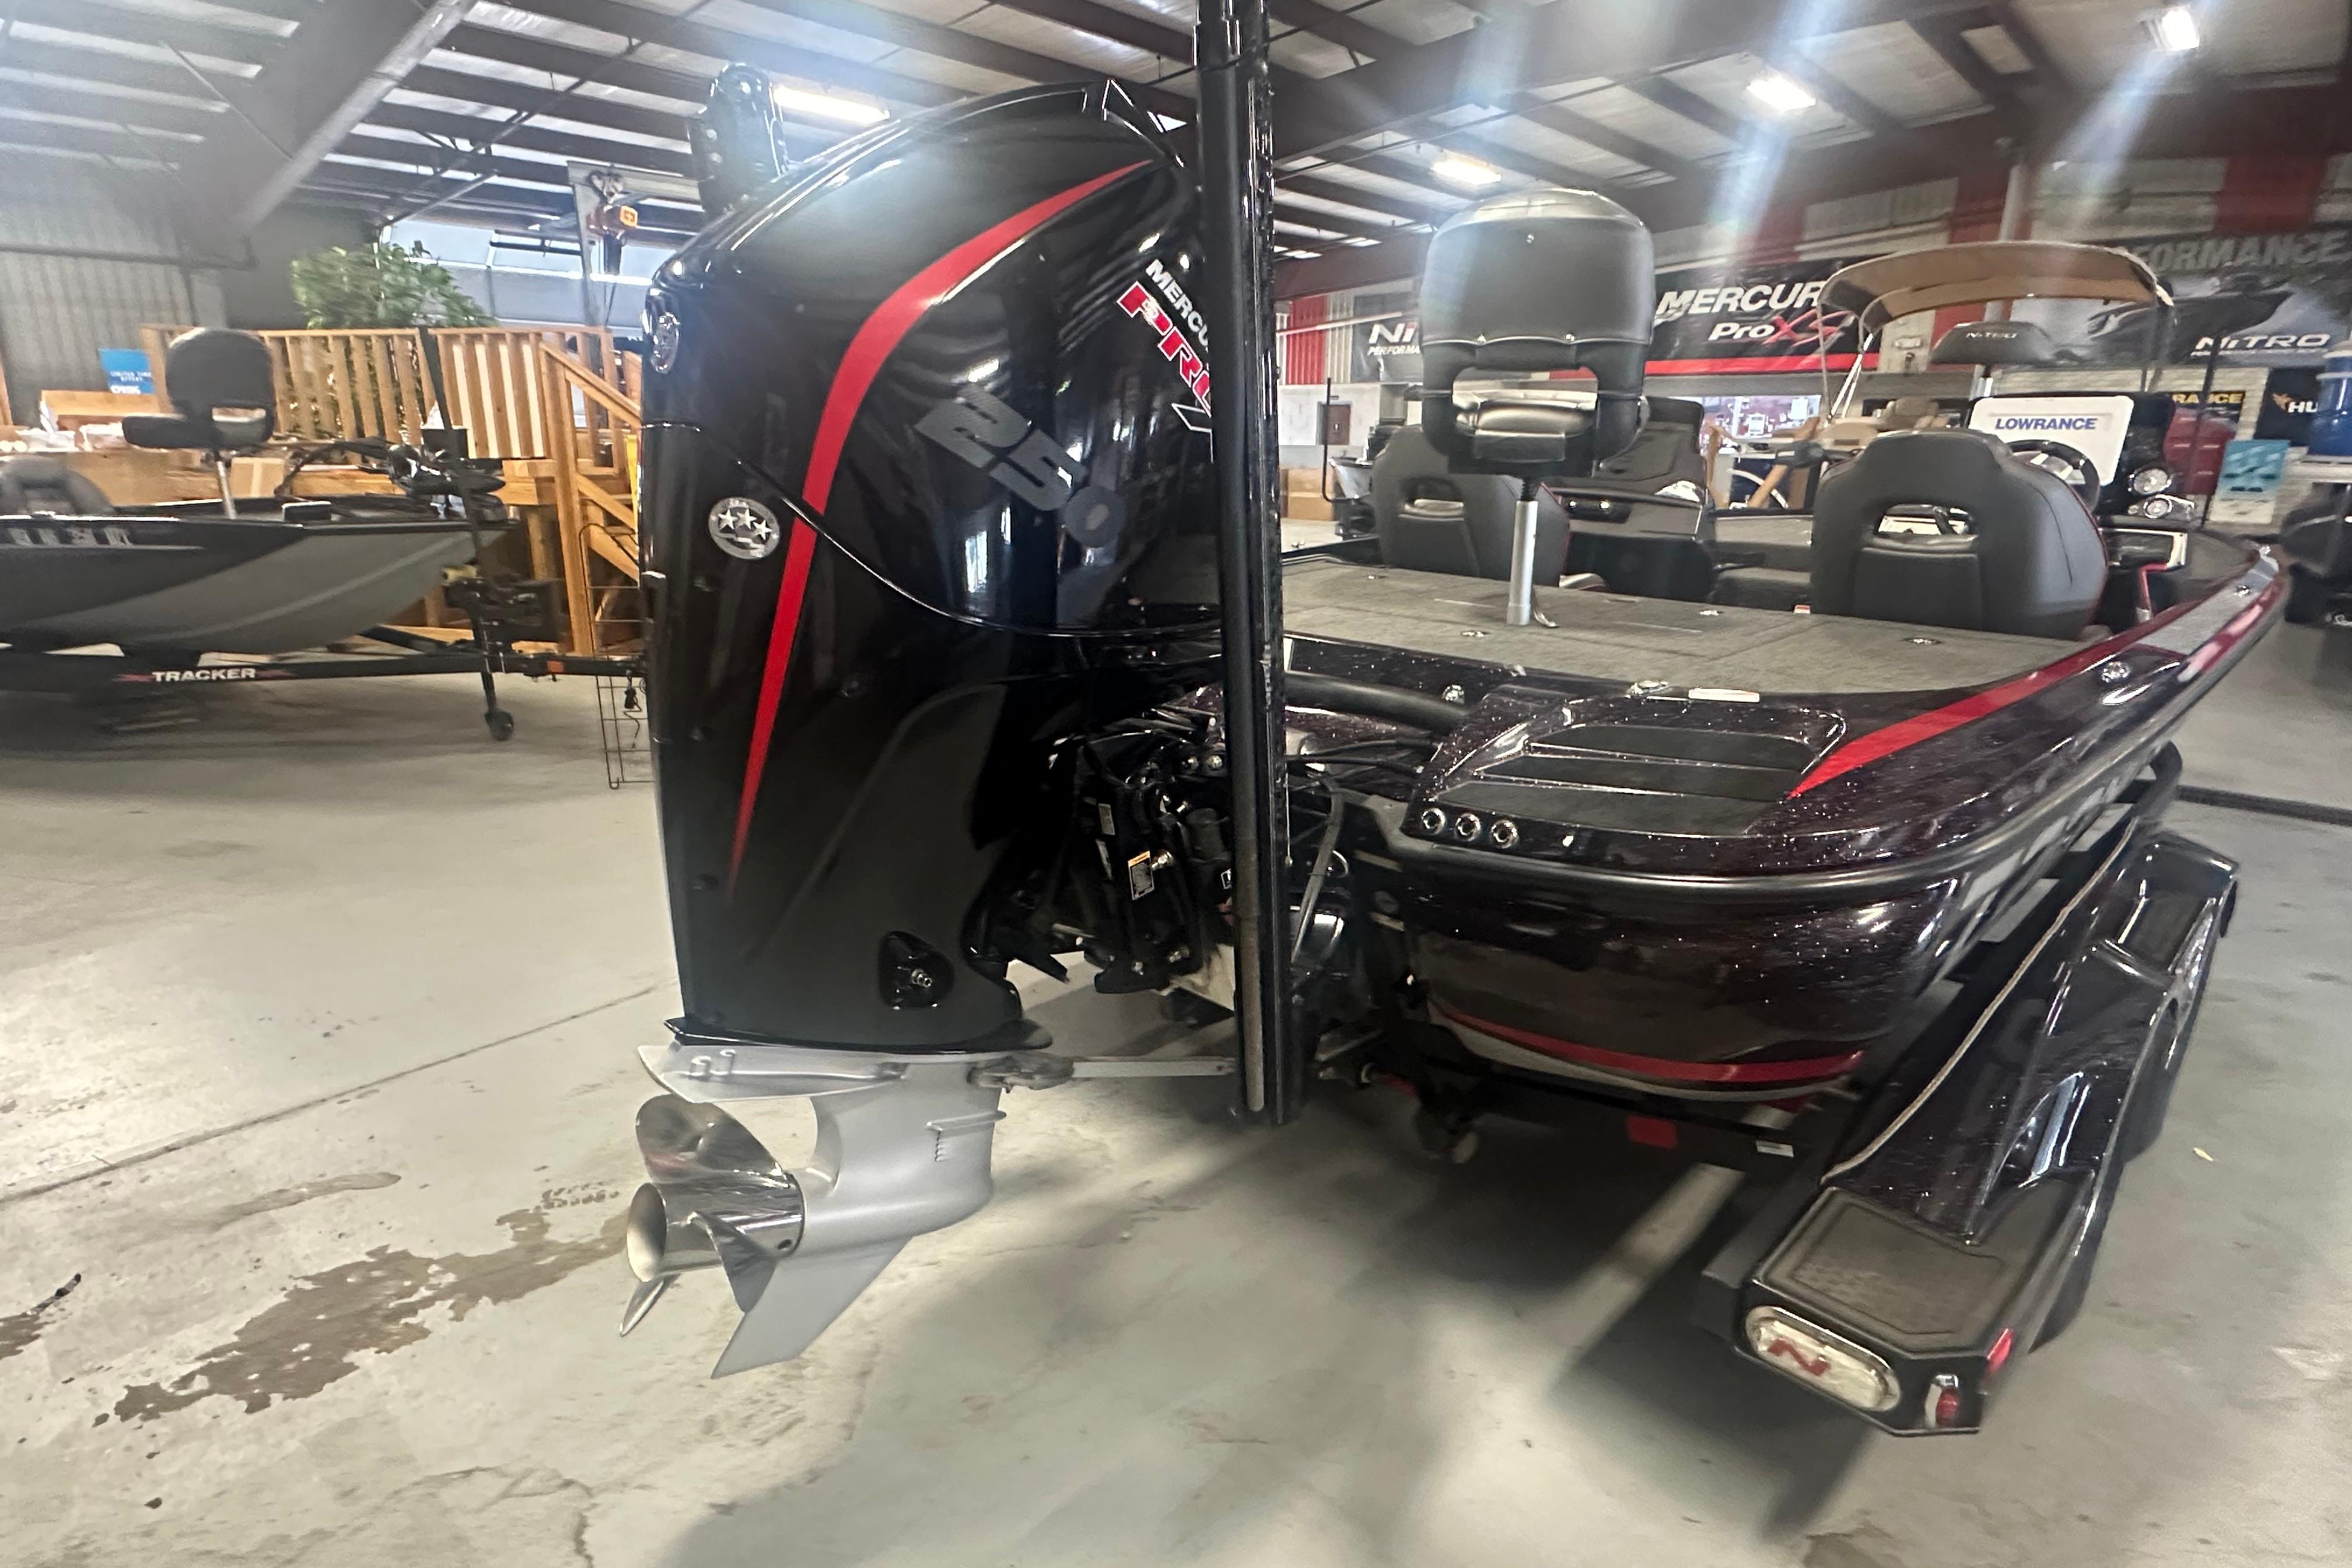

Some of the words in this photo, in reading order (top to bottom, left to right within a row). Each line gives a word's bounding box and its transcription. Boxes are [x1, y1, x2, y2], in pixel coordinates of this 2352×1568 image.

[1146, 259, 1209, 353] MERCU
[1654, 281, 1826, 327] MERCUR
[1367, 345, 1420, 355] PERFORMA
[1994, 417, 2098, 430] LOWRANCE
[915, 383, 1126, 548] 250
[152, 668, 256, 682] TRACKER
